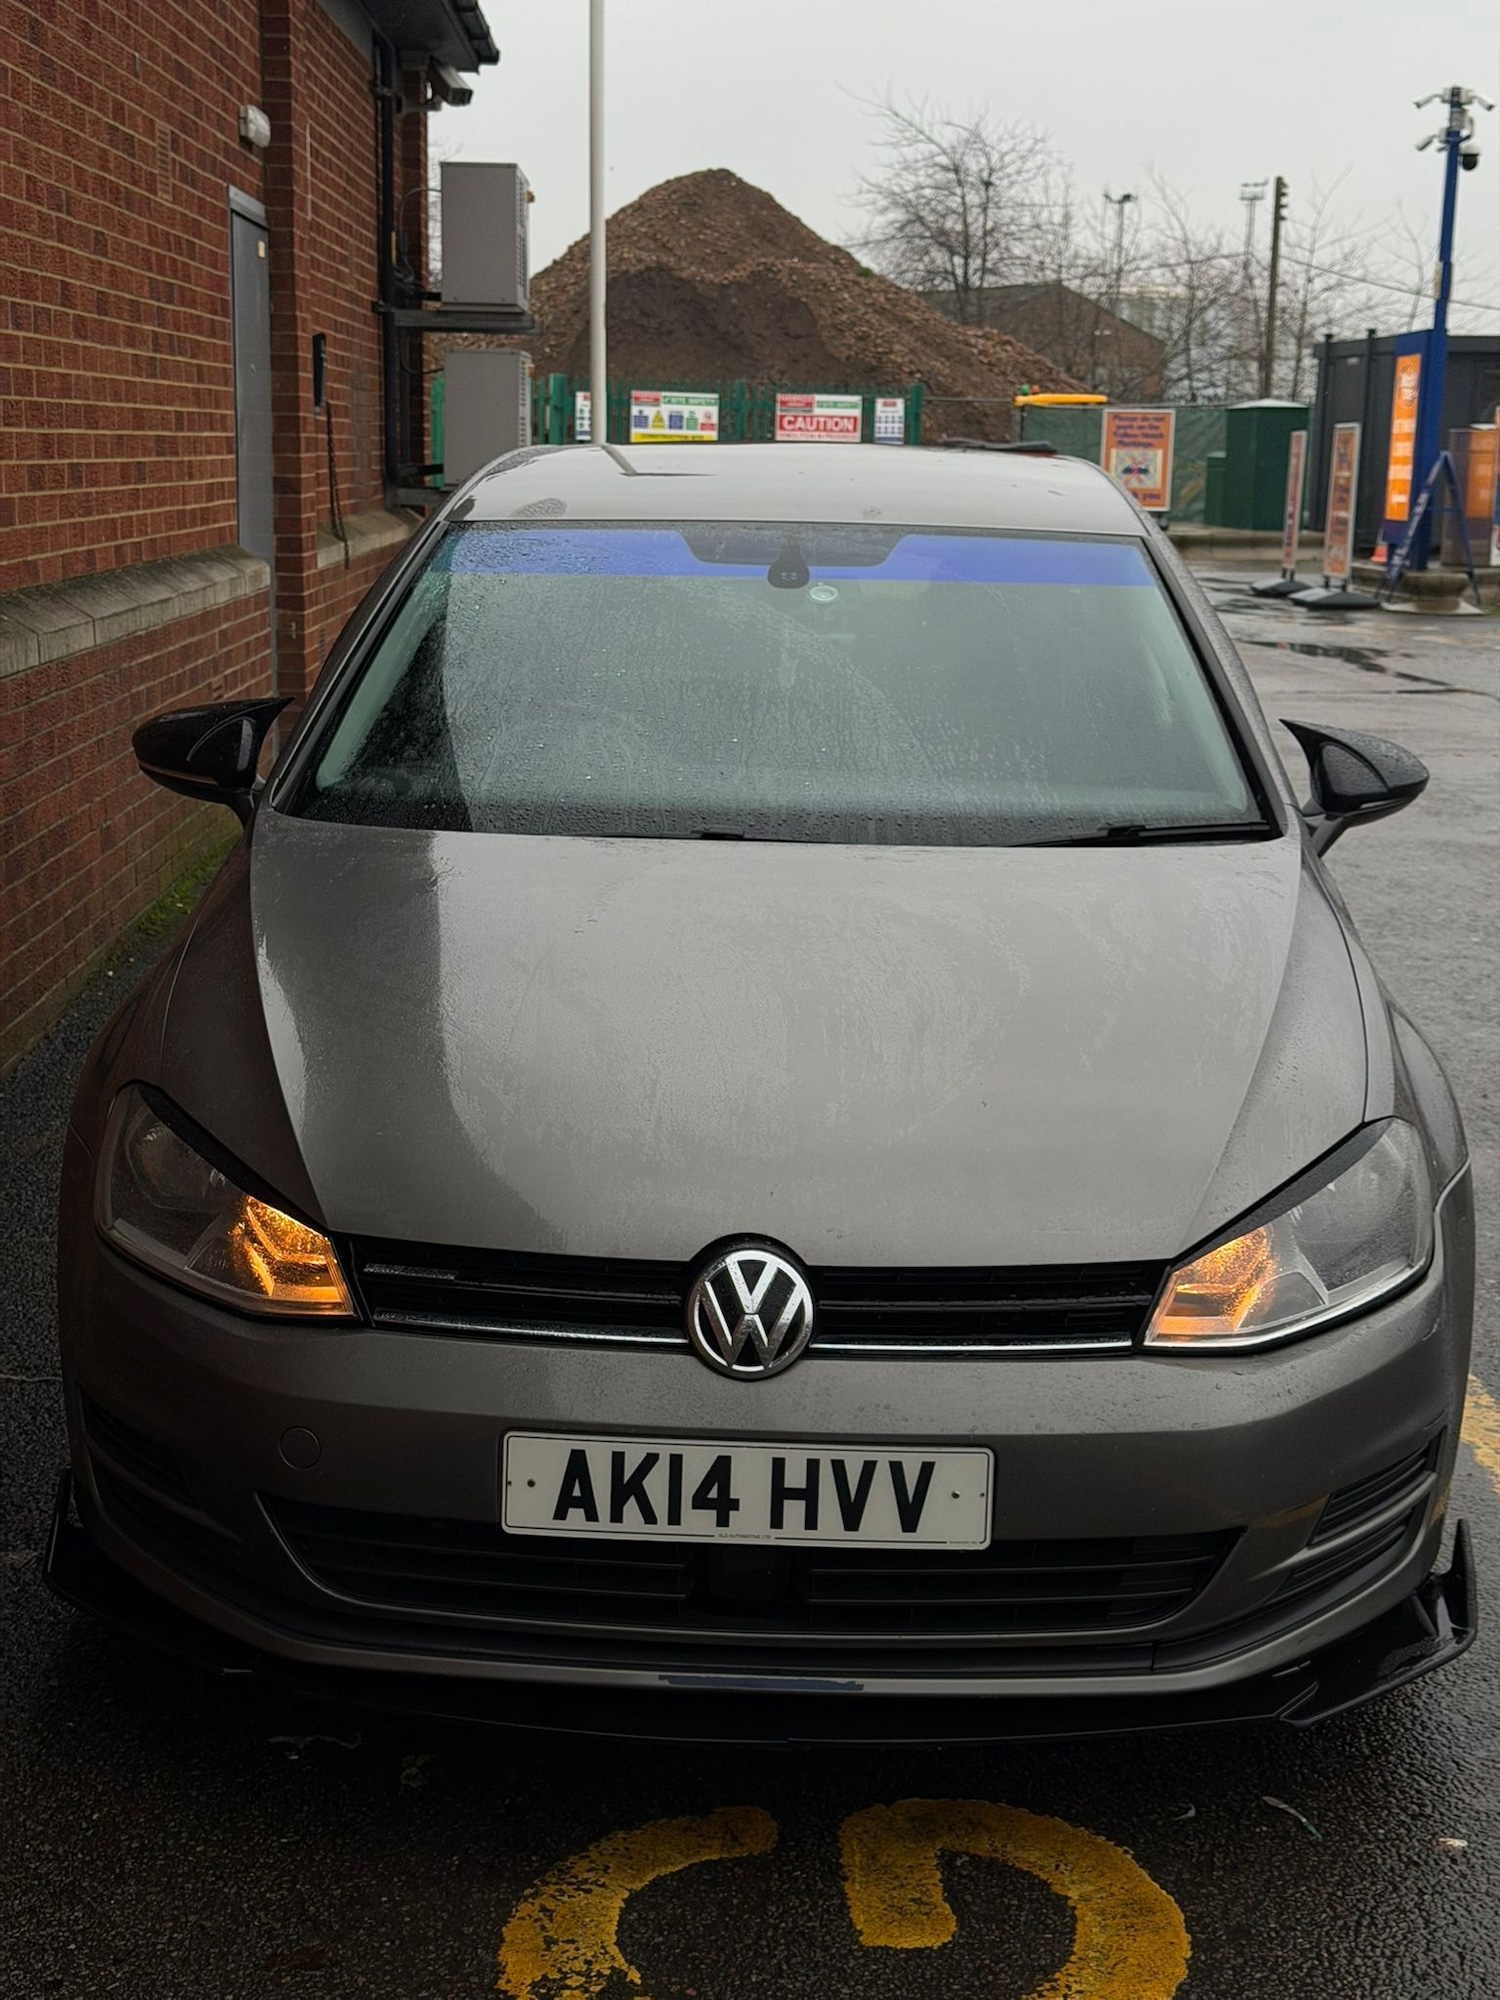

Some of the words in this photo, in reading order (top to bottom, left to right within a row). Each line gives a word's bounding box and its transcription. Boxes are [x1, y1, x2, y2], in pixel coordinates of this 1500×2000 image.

[782, 416, 854, 432] CAUTION
[552, 1449, 740, 1528] AK14
[769, 1456, 936, 1533] HVV
